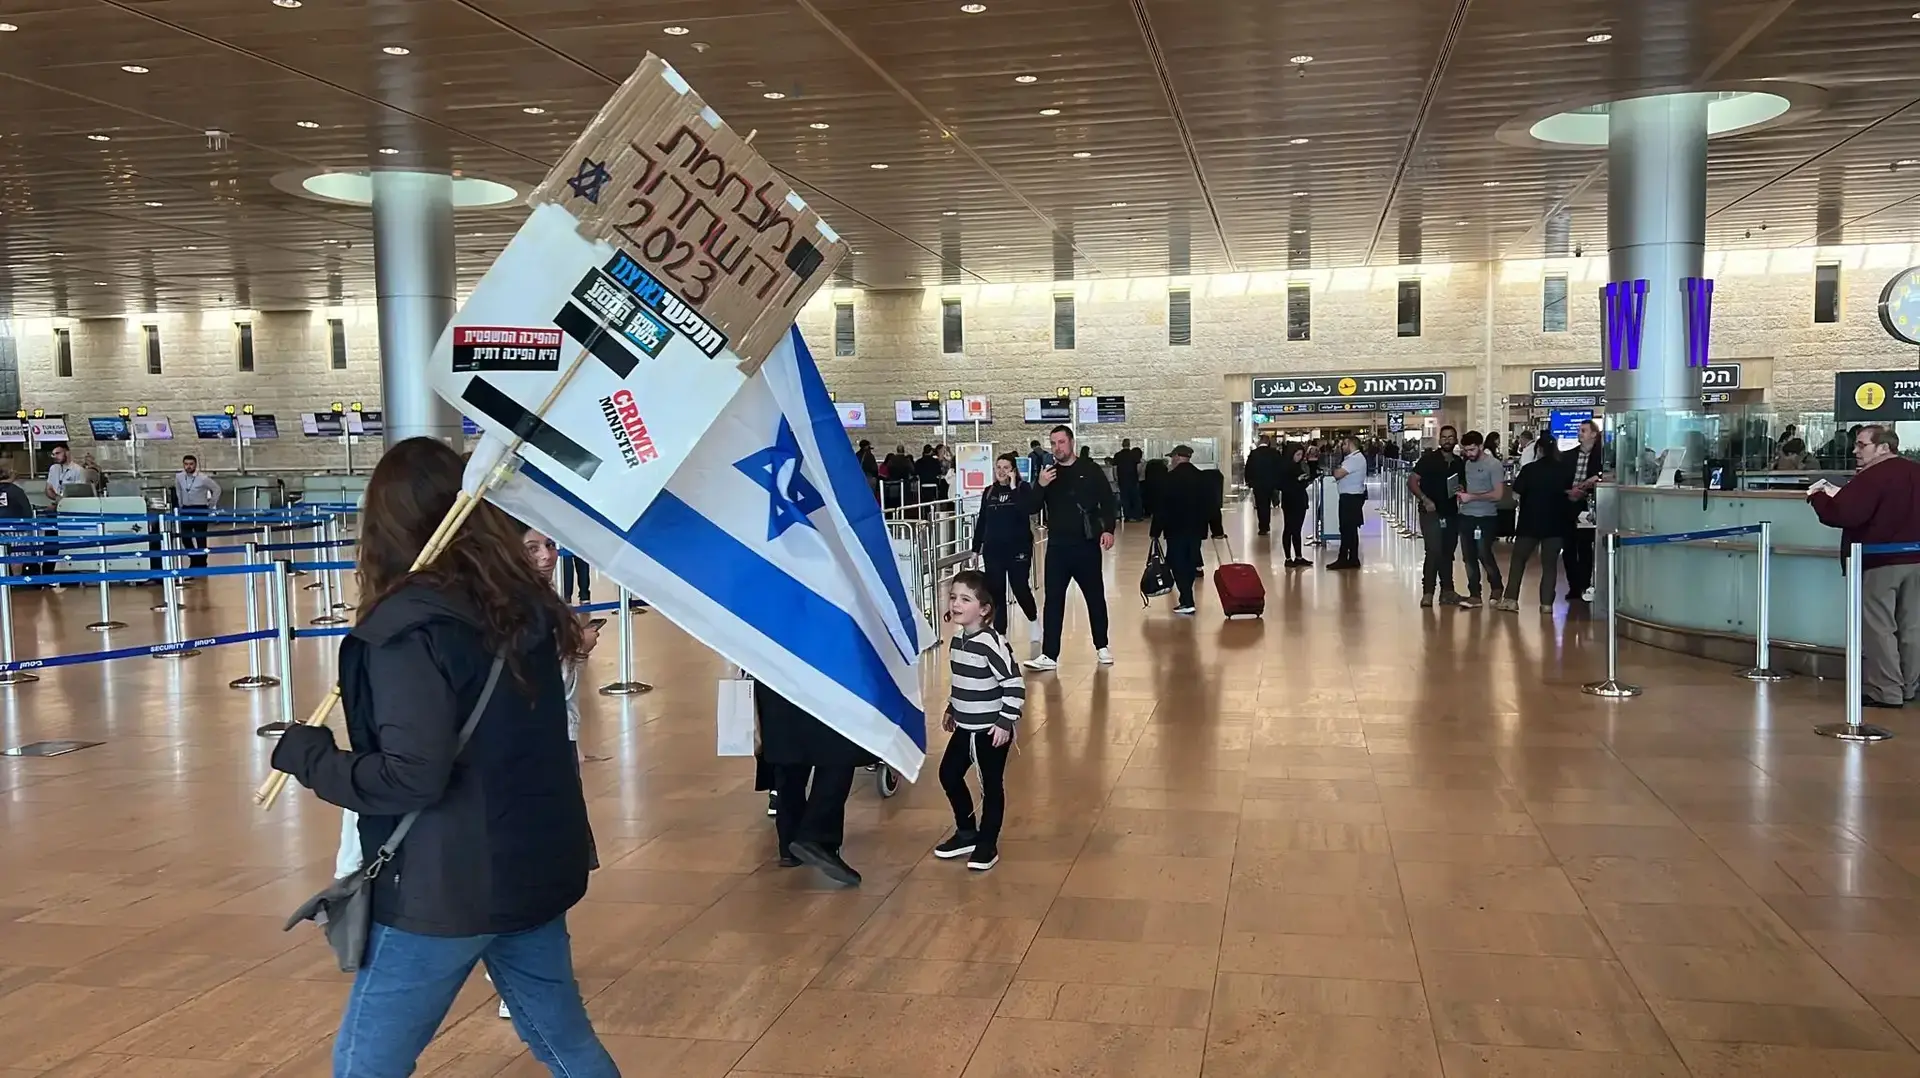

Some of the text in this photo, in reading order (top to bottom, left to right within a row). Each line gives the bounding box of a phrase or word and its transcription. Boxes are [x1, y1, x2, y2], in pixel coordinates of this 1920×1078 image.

[655, 125, 794, 253] מלחמת
[628, 140, 780, 299] השחרור
[613, 198, 718, 304] 2023
[611, 256, 666, 307] בארצנו
[464, 330, 560, 344] ההפיכה המשפטית
[661, 292, 724, 354] חופשי
[1606, 280, 1646, 370] W
[473, 347, 557, 361] היא הפיכה דתית
[1299, 381, 1331, 395] رحلات
[1364, 378, 1437, 392] המראות
[1894, 381, 1920, 389] ירות
[599, 396, 640, 468] MINISTER
[613, 389, 659, 463] CRIME
[150, 643, 185, 653] SECURITY
